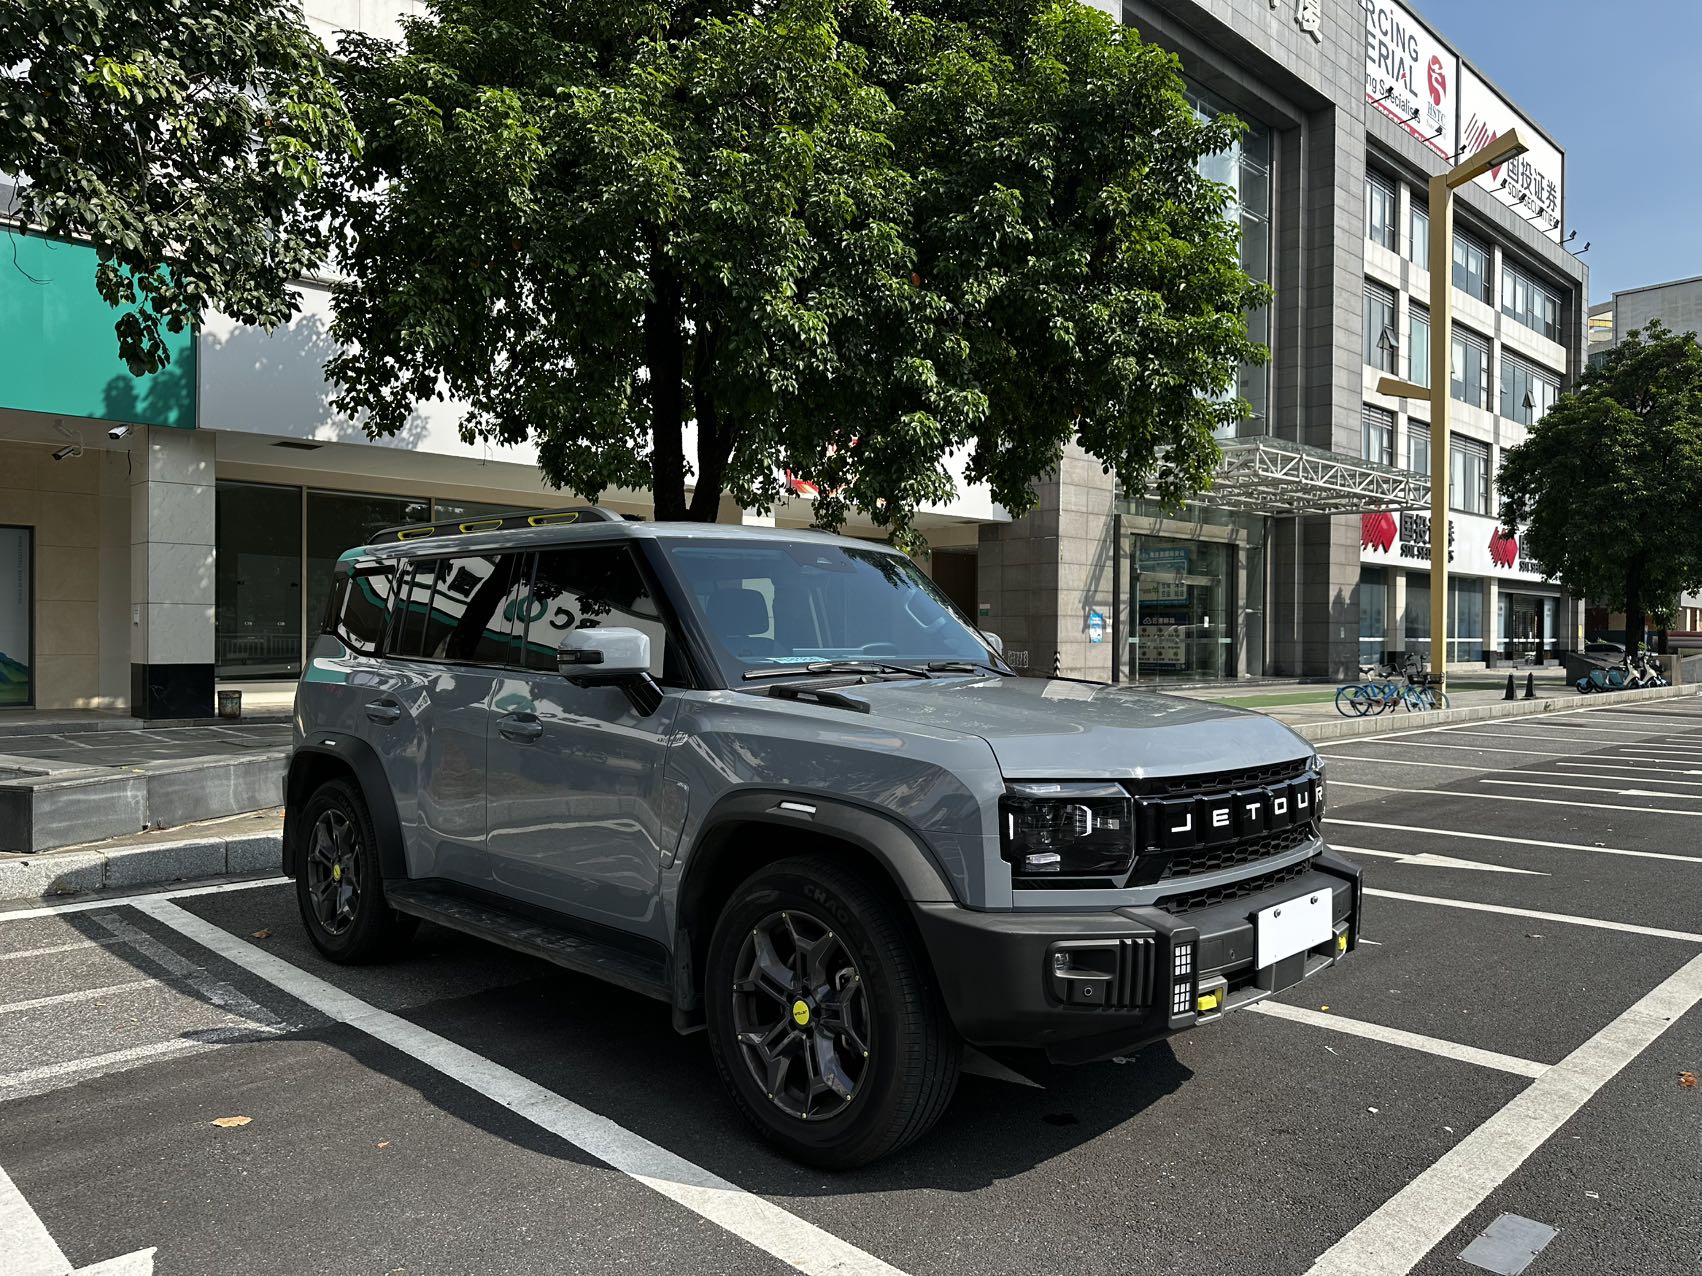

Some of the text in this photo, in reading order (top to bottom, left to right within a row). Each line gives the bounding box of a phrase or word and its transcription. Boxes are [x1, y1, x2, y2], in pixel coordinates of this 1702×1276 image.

[1507, 155, 1557, 213] 国投证券
[1400, 510, 1455, 548] 国投
[1171, 786, 1323, 833] JETOUR
